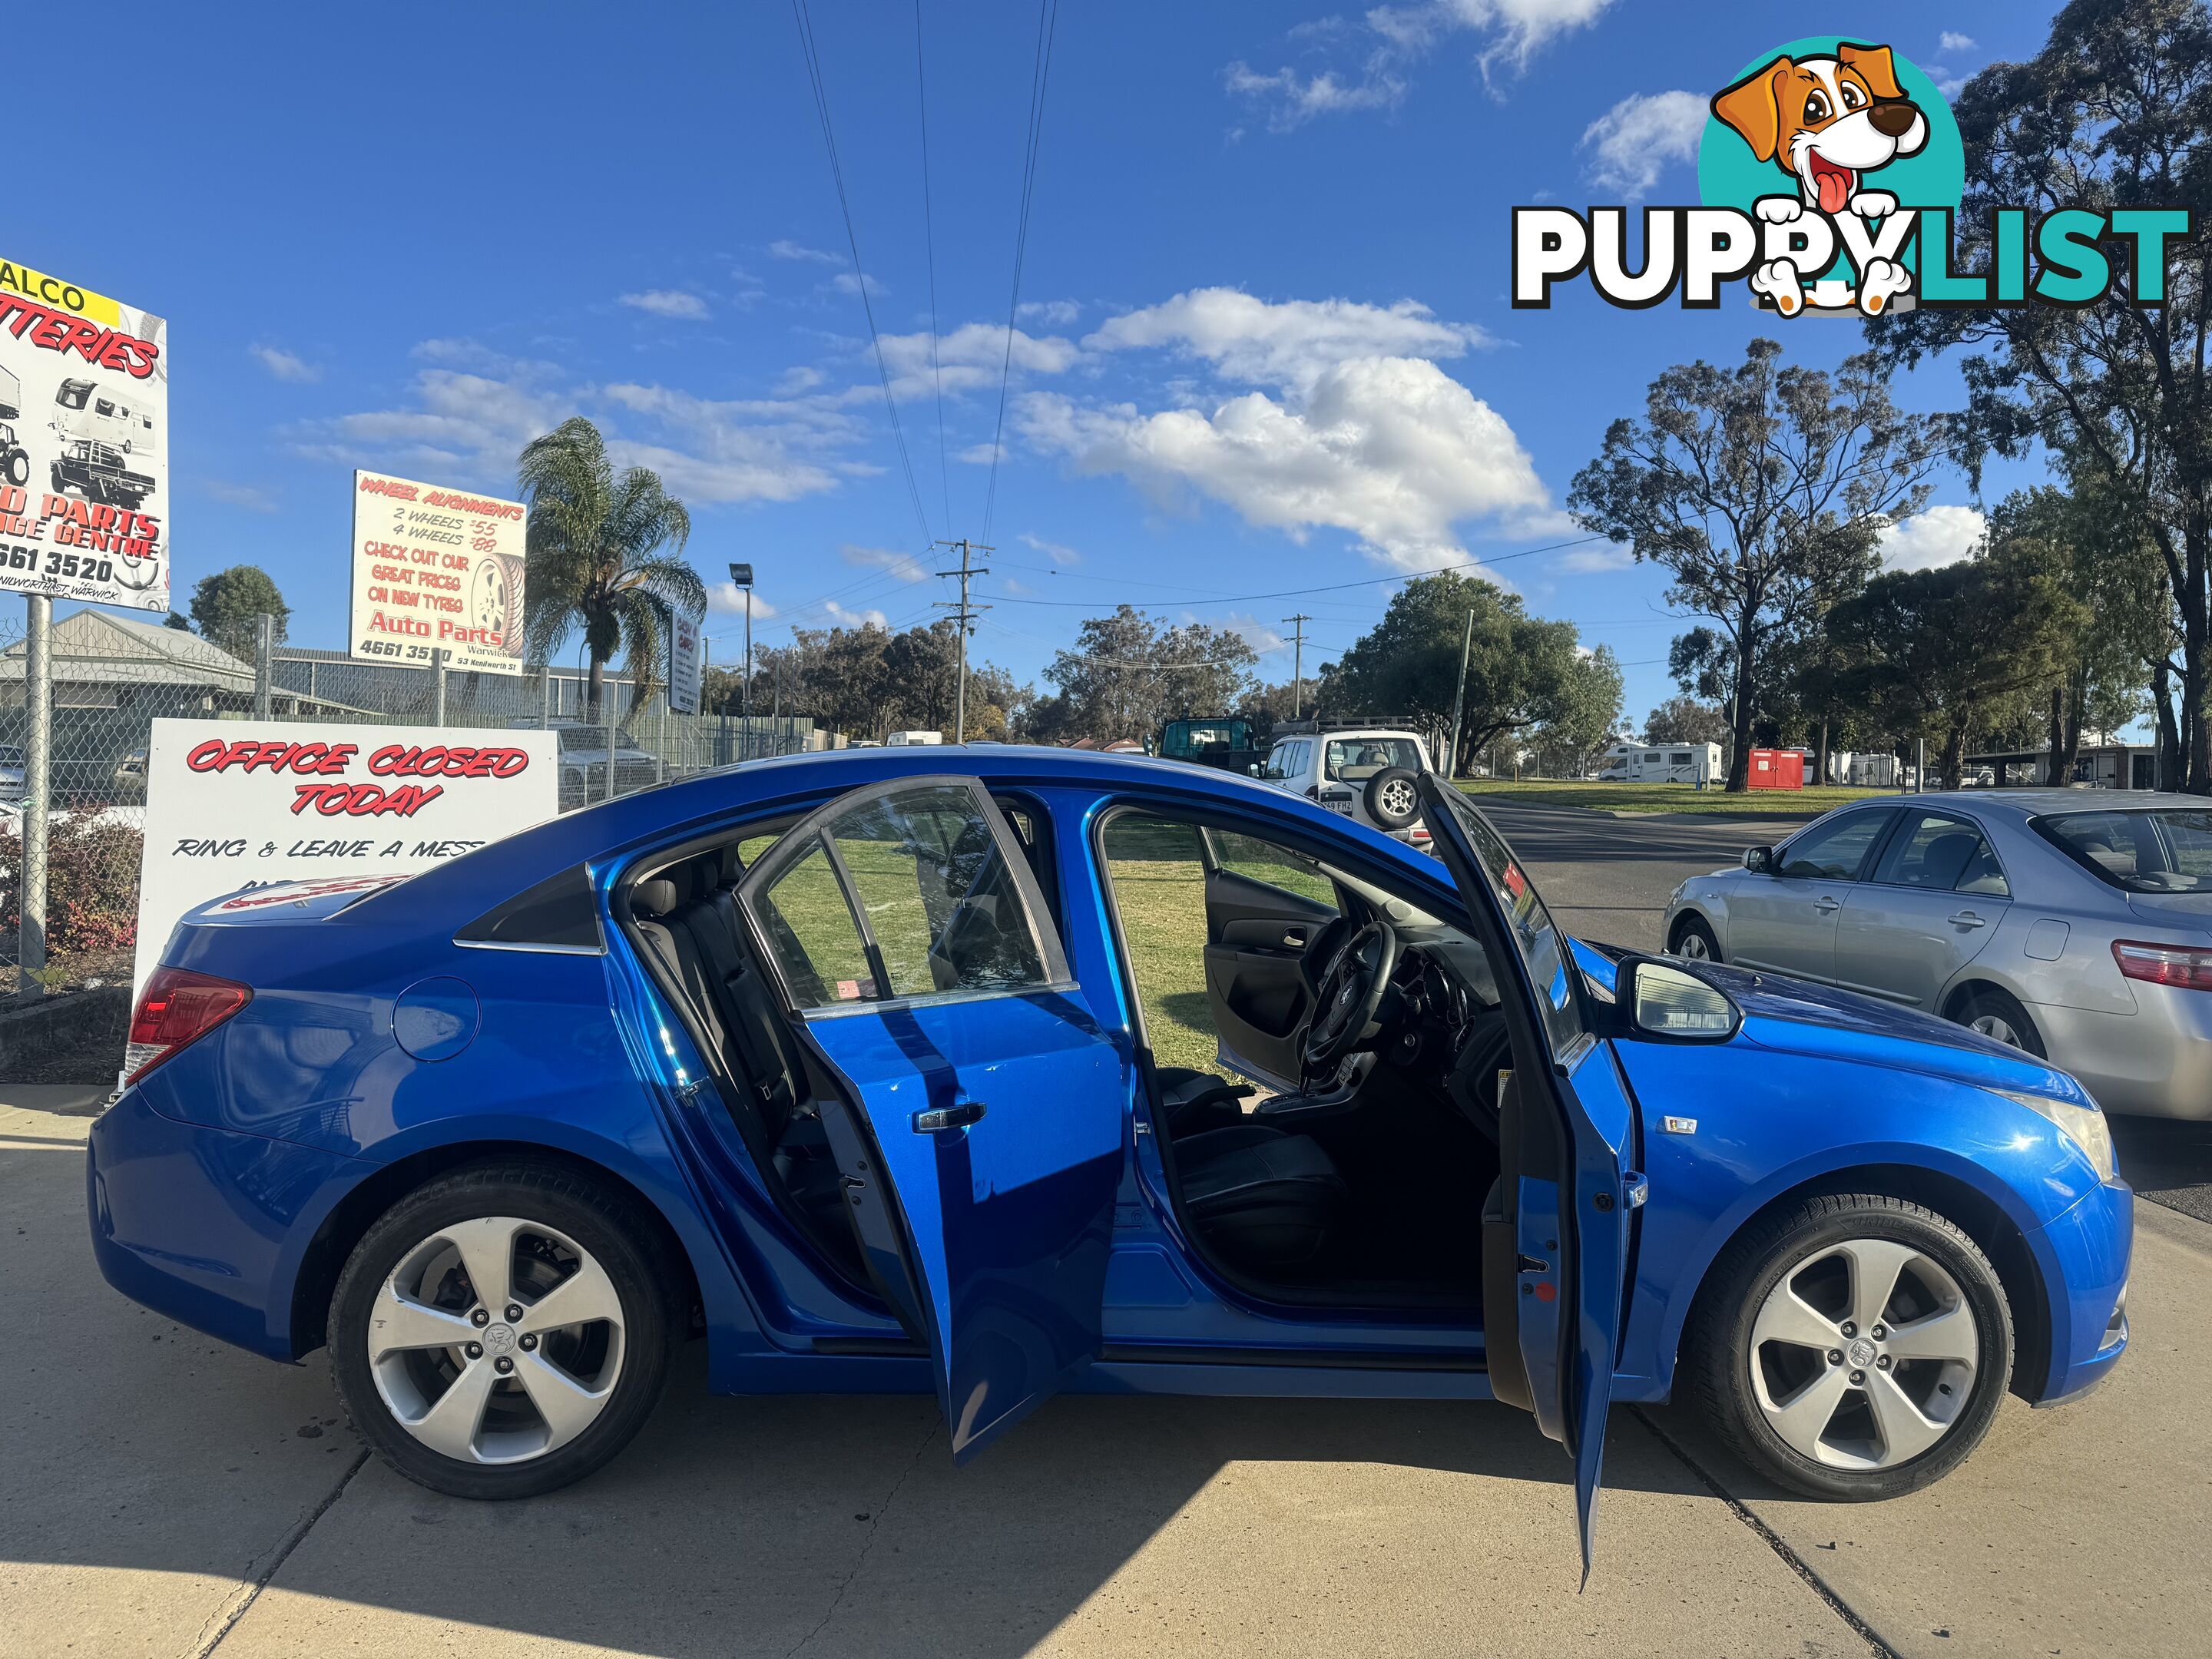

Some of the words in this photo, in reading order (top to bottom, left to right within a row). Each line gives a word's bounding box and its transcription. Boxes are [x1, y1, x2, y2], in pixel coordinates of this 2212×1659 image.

[0, 262, 84, 312] ALCO
[359, 477, 419, 501] WHEEL
[422, 491, 524, 521] ALIGNMENTS
[41, 493, 161, 541] PARTS
[393, 508, 405, 519] 2
[408, 511, 464, 530] WHEELS
[55, 524, 160, 561] CENTRE
[393, 524, 404, 535] 4
[408, 526, 464, 545] WHEELS
[45, 551, 112, 582] 3520
[364, 541, 408, 561] CHECK
[411, 548, 439, 566] OUT
[442, 554, 469, 571] OUR
[55, 584, 70, 593] ST
[71, 586, 119, 600] WARWICK
[372, 565, 415, 584] GREAT
[418, 571, 461, 591] PRICES
[368, 586, 388, 603] ON
[392, 589, 420, 607] NEW
[423, 594, 463, 613] TYRES
[369, 611, 431, 638] Auto
[439, 619, 503, 647] Parts
[359, 640, 402, 657] 4661
[406, 645, 452, 662] 350
[467, 645, 508, 657] Warwick
[470, 659, 507, 670] Kenilworth
[187, 739, 359, 774] OFFICE
[368, 745, 529, 779] CLOSED
[290, 783, 444, 817] TODAY
[172, 839, 247, 858] RING
[258, 841, 278, 858] &
[286, 839, 375, 858] LEAVE
[379, 839, 404, 858] A
